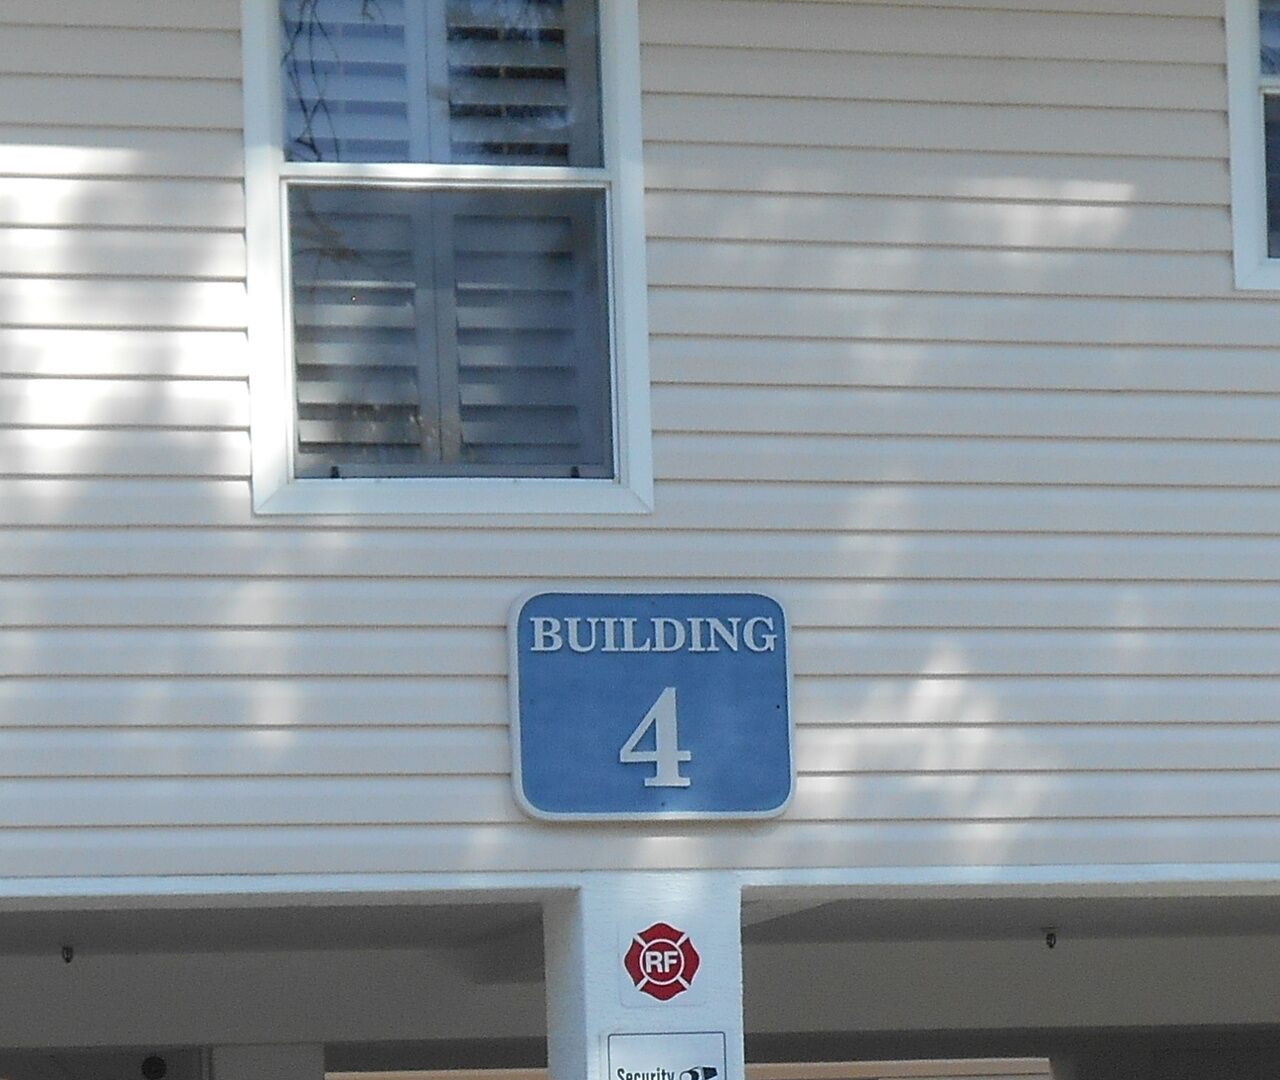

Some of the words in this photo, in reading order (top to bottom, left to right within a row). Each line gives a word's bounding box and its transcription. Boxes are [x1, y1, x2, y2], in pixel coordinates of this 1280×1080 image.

[530, 616, 777, 652] BUILDING
[619, 686, 692, 787] 4
[645, 950, 679, 974] RF
